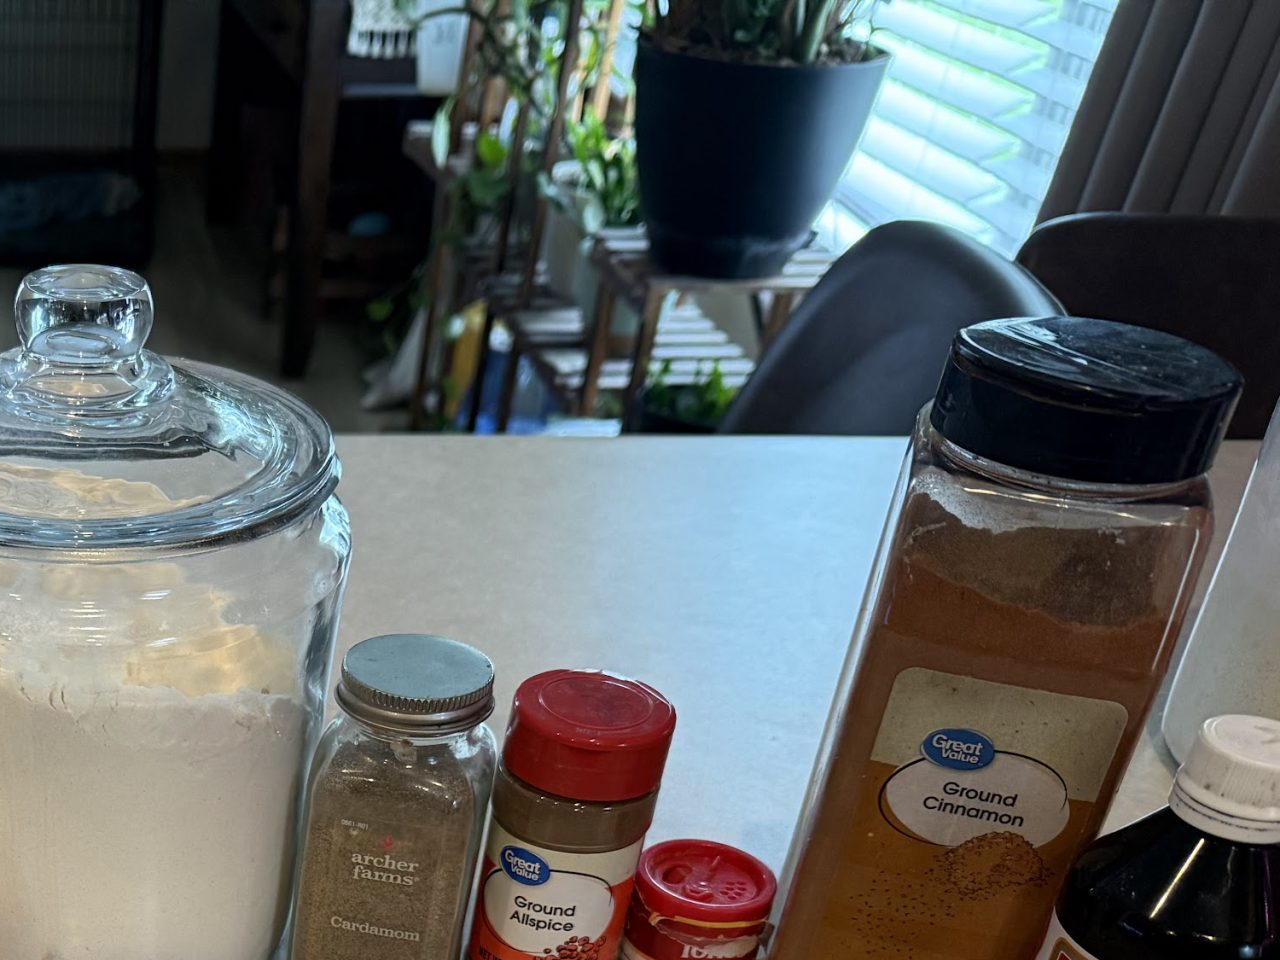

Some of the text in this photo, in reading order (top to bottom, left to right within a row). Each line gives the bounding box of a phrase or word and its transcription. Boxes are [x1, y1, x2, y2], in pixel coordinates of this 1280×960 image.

[932, 733, 983, 756] Great
[941, 747, 980, 765] Value
[942, 781, 1019, 808] Ground
[922, 795, 1025, 828] Cinnamon
[351, 853, 419, 873] archer
[504, 849, 541, 874] Great
[510, 863, 539, 881] Value
[352, 865, 415, 886] farms
[514, 895, 576, 917] Ground
[330, 915, 420, 942] Cardamom
[509, 910, 574, 932] Allspice
[479, 946, 491, 960] NET
